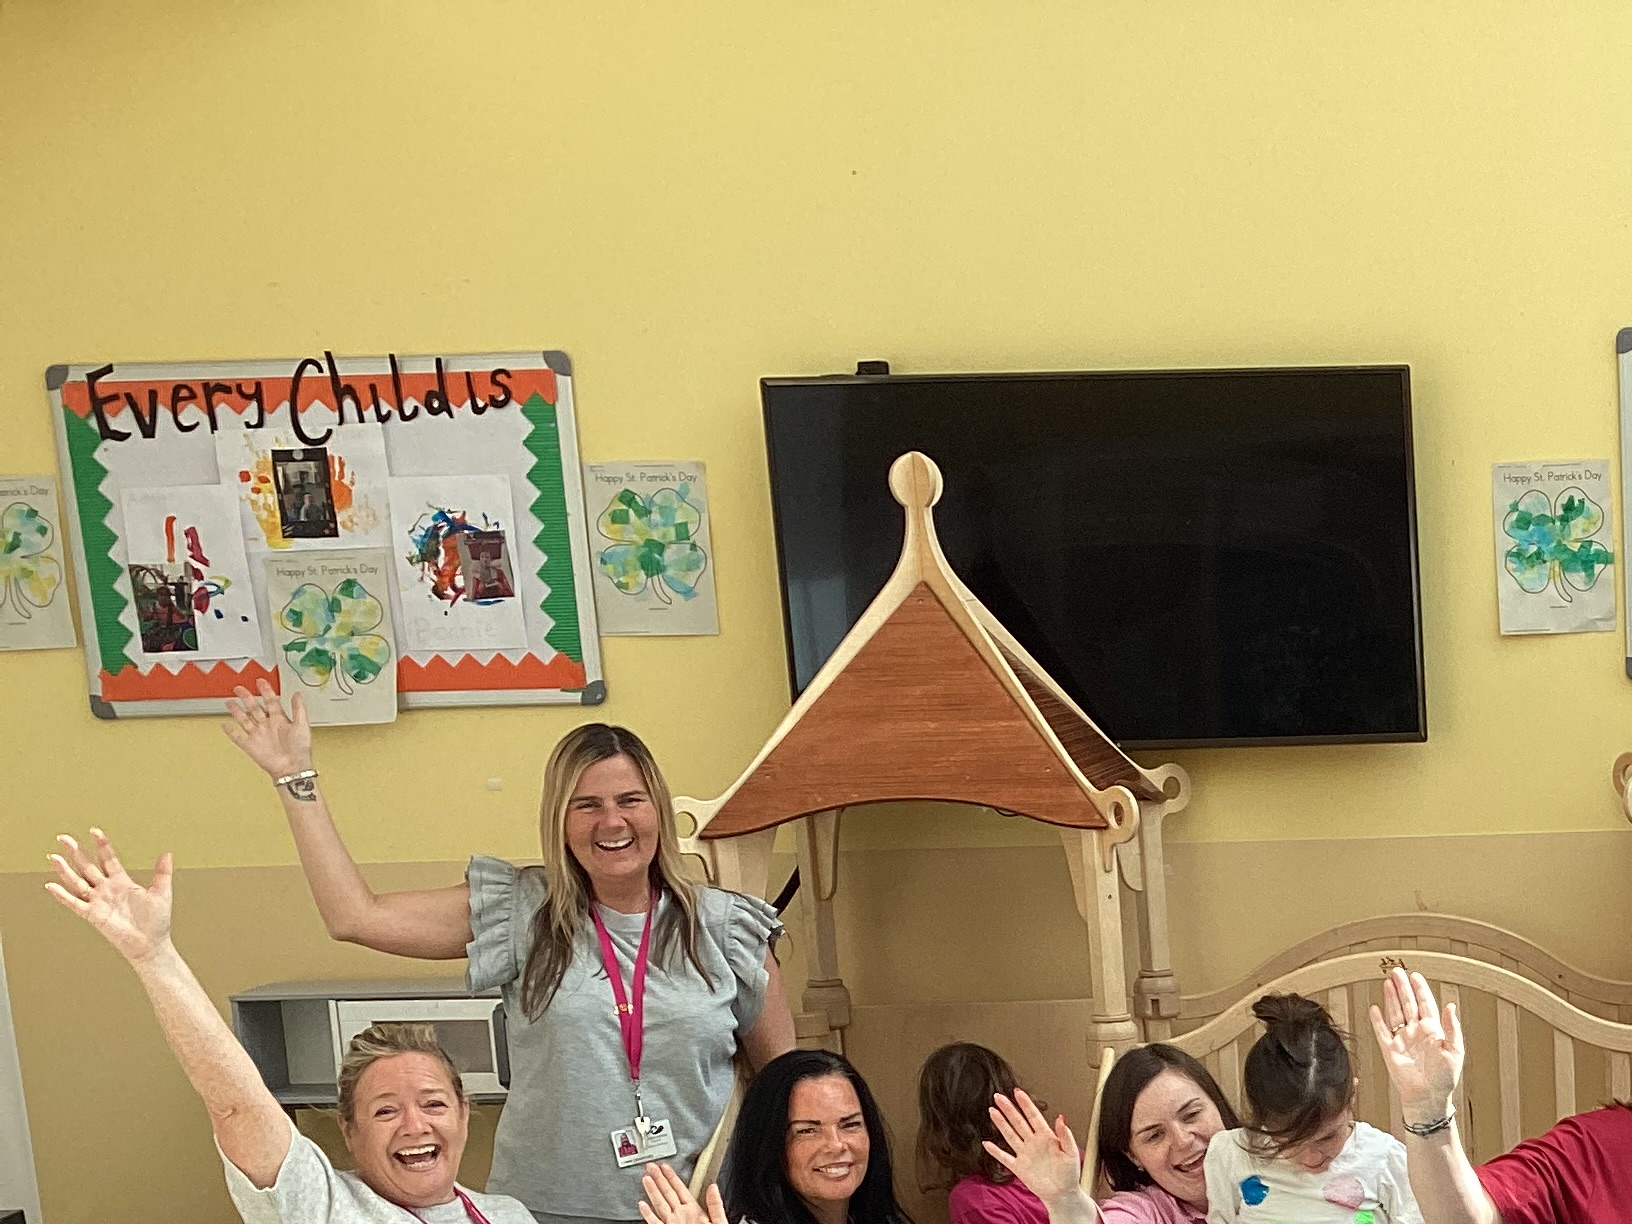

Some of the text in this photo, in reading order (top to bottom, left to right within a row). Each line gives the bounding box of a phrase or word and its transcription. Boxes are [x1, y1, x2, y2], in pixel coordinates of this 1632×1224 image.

[86, 351, 513, 446] Every Child is
[595, 473, 624, 486] Happy
[678, 471, 698, 483] Day
[1503, 473, 1532, 485] Happy
[1584, 469, 1602, 482] Day
[277, 567, 305, 579] Happy
[360, 563, 379, 575] Day
